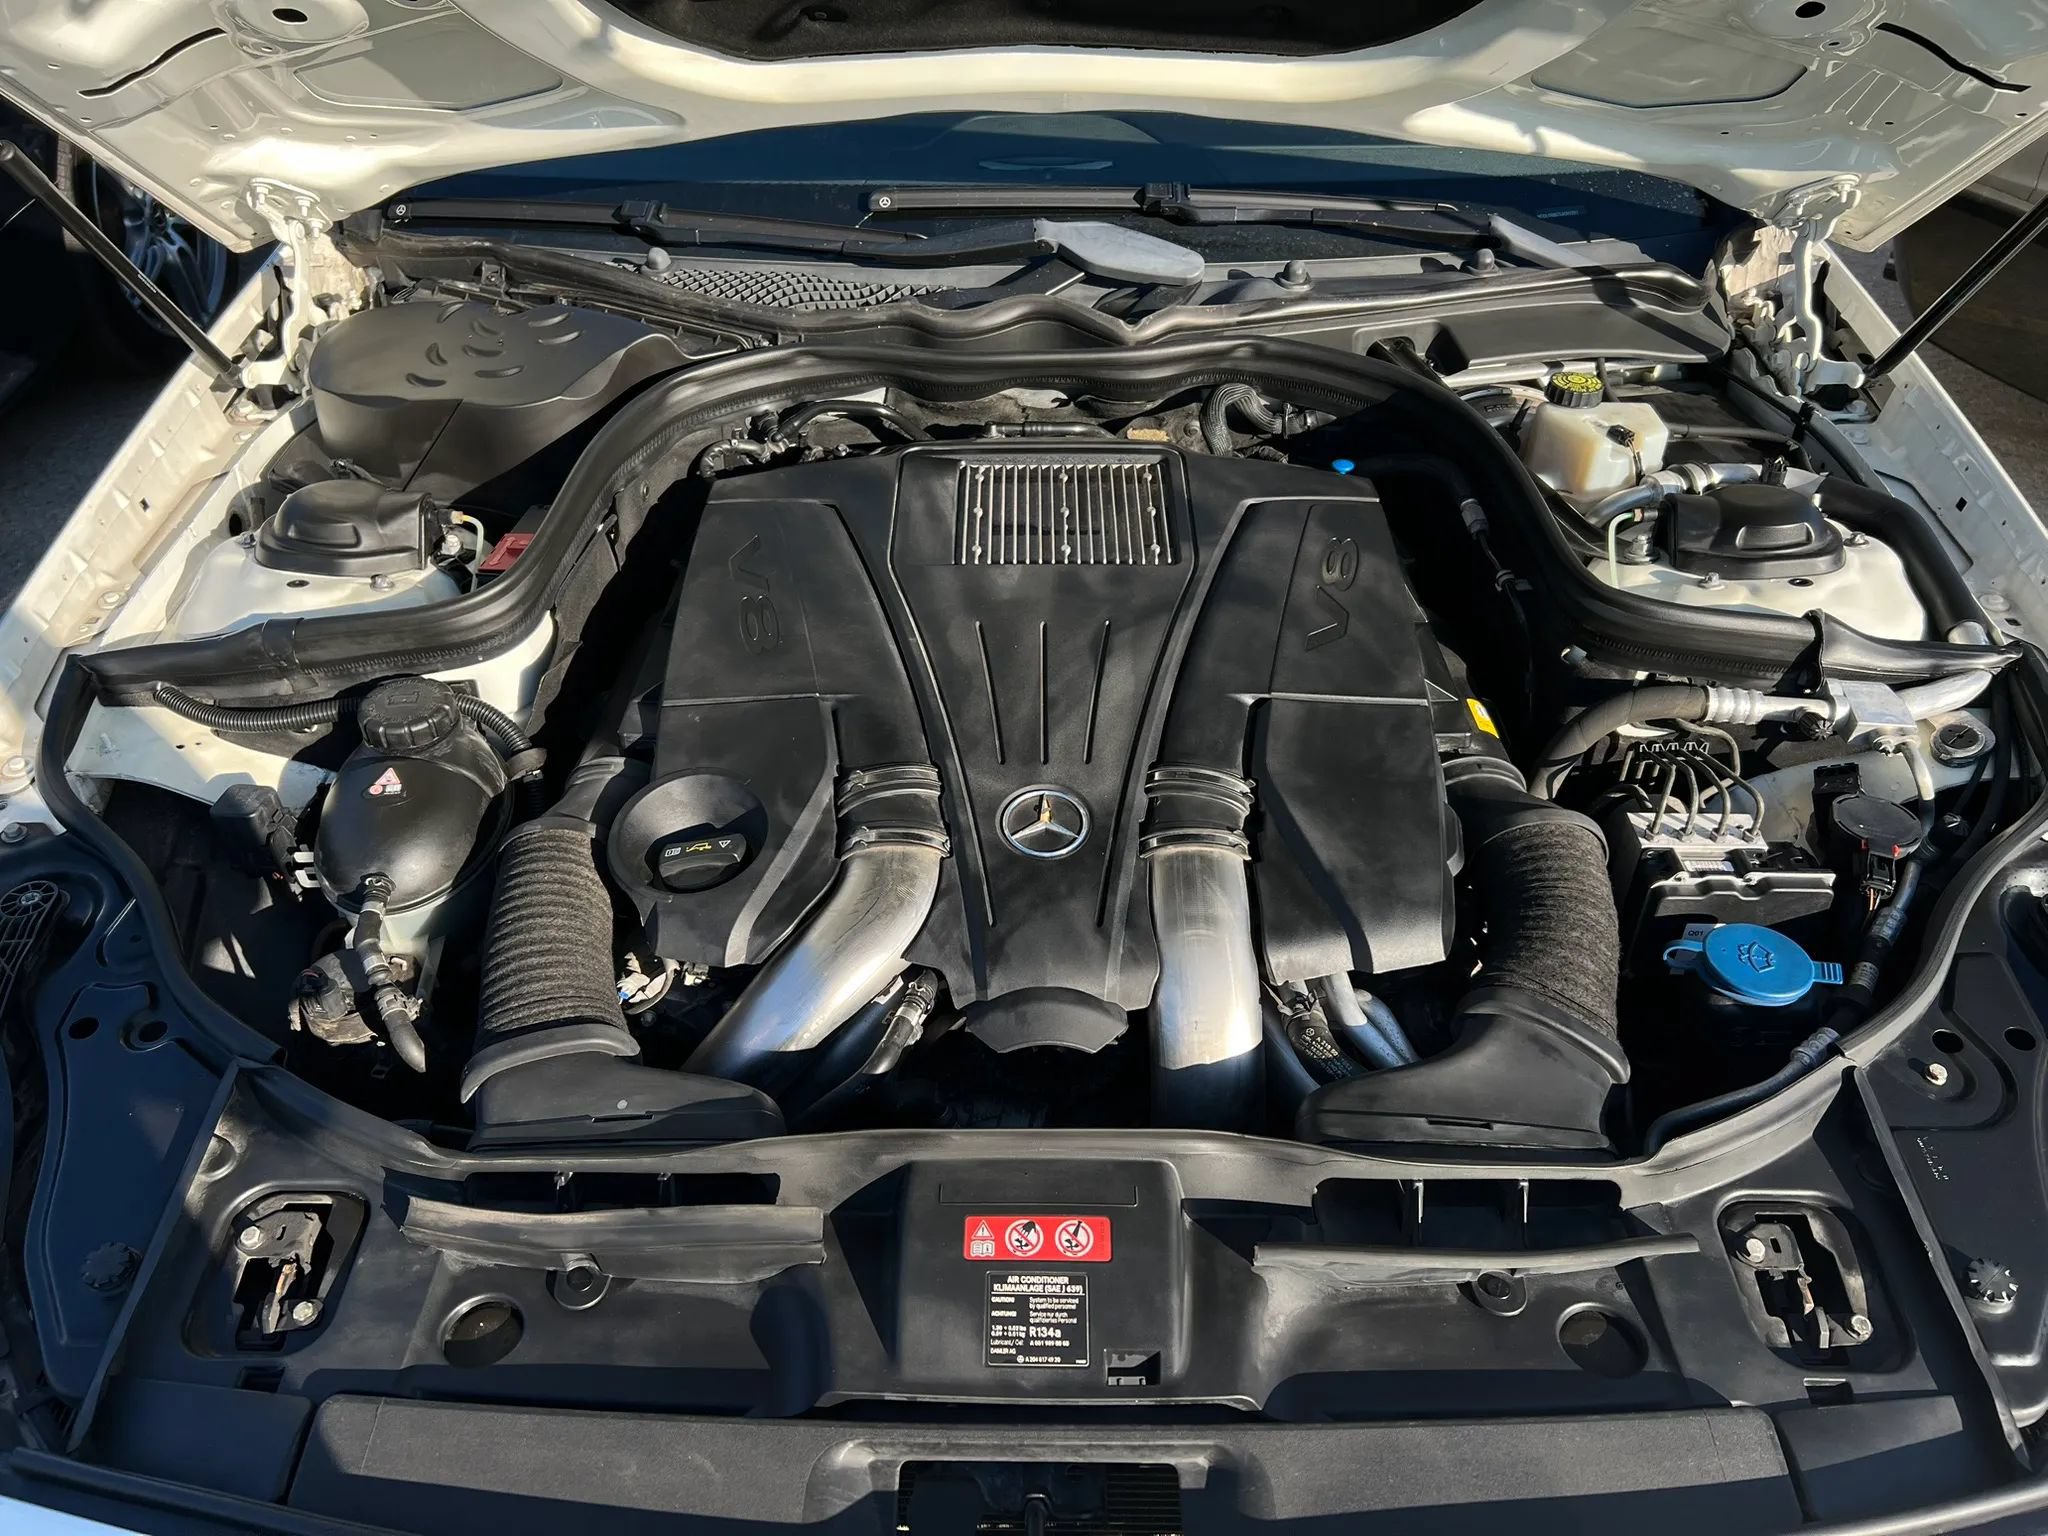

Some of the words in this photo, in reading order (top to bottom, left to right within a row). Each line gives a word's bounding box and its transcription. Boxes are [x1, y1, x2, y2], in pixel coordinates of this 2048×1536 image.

[728, 534, 782, 657] V8
[1304, 536, 1360, 652] V8
[1007, 1275, 1019, 1284] AIR
[1020, 1276, 1069, 1285] CONDITIONER
[993, 1283, 1044, 1292] KLIMAANLAGE
[1045, 1284, 1061, 1294] (SAE
[1061, 1284, 1066, 1293] J
[1066, 1285, 1083, 1295] 639)
[1029, 1296, 1047, 1304] System
[1029, 1310, 1046, 1318] Service
[1029, 1326, 1062, 1338] R134a
[990, 1339, 1014, 1347] Lubricant/
